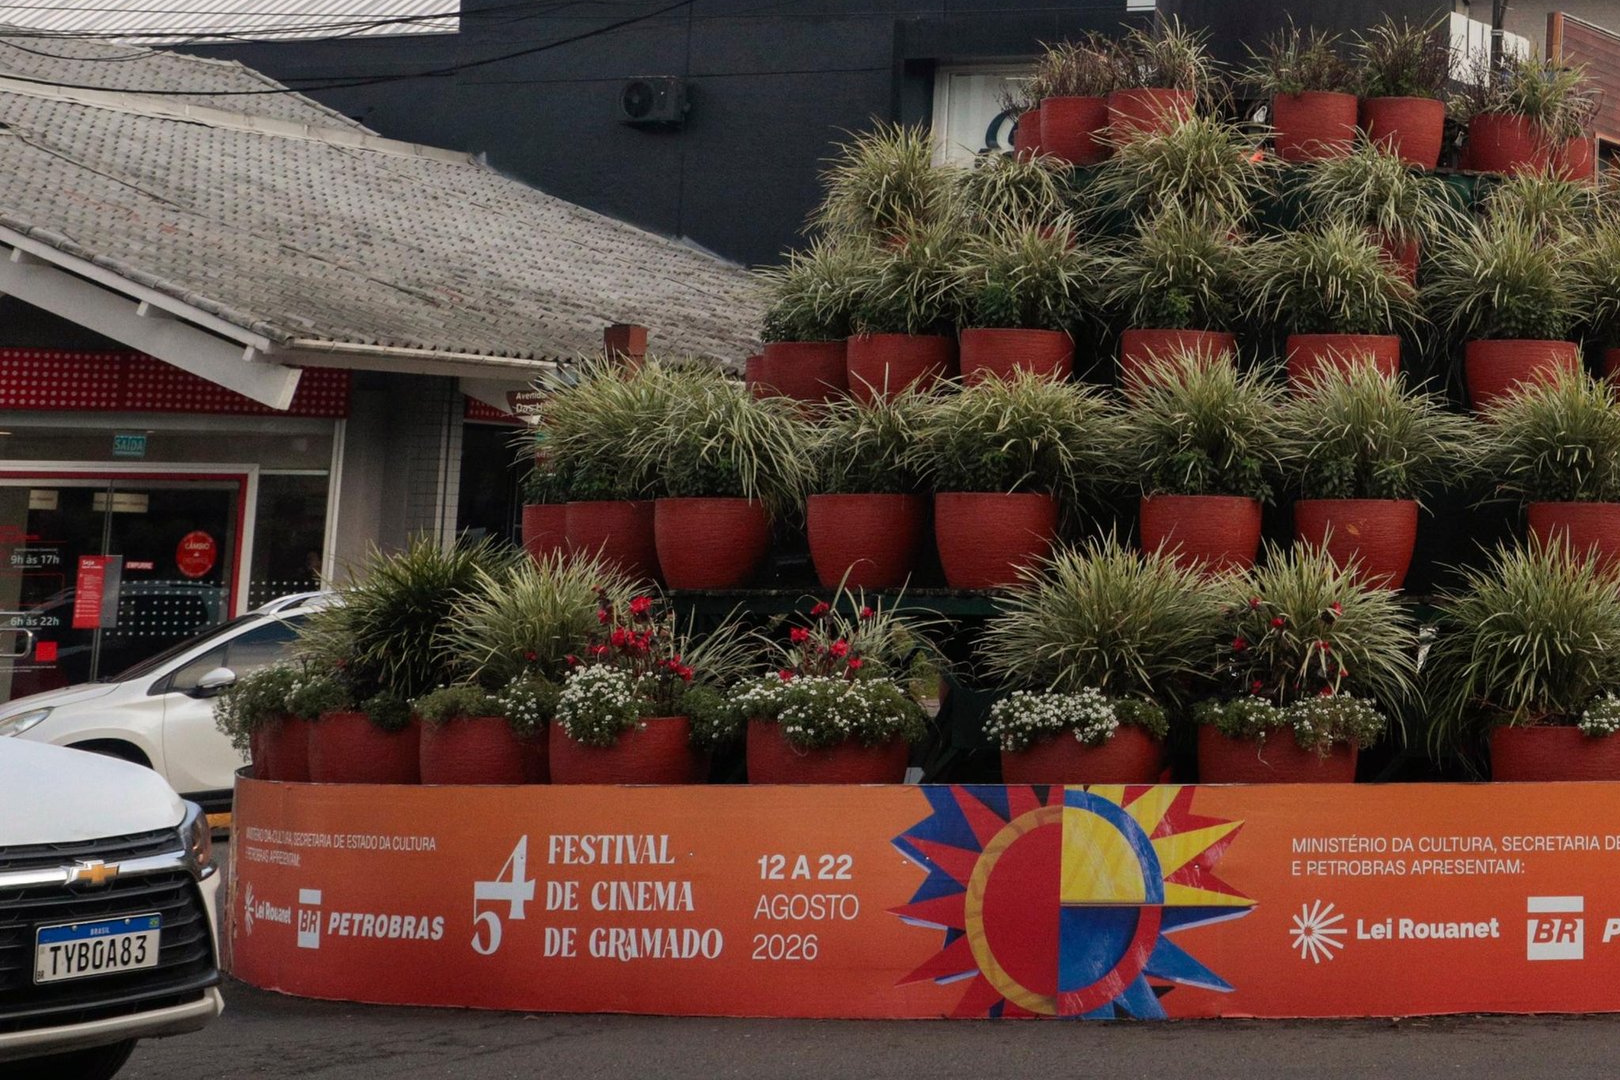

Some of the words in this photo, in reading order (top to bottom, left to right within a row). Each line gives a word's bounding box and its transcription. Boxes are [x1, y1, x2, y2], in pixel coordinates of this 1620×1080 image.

[11, 555, 23, 565] 9h
[41, 555, 60, 565] 17h
[10, 616, 23, 626] 6h
[40, 616, 60, 626] 22h
[334, 834, 345, 848] DE
[346, 834, 377, 849] ESTADO
[379, 836, 391, 850] DA
[392, 836, 436, 851] CULTURA
[548, 834, 675, 865] FESTIVAL
[1292, 834, 1387, 853] MINISTÉRIO
[1392, 838, 1414, 853] DA
[1418, 837, 1498, 854] CULTURA,
[1502, 835, 1600, 851] SECRETARIA
[758, 854, 786, 880] 12
[791, 854, 811, 880] A
[817, 854, 853, 880] 22
[1292, 860, 1301, 876] E
[1307, 860, 1406, 876] PETROBRAS
[1410, 859, 1525, 875] APRESENTAM:
[545, 880, 579, 911] DE
[590, 880, 695, 911] CINEMA
[753, 894, 860, 920] AGOSTO
[255, 900, 265, 919] Lei
[266, 902, 291, 925] Rouanet
[300, 910, 318, 934] BR
[89, 927, 110, 936] BRASIL
[328, 912, 445, 941] PETROBRAS
[1357, 918, 1393, 940] Lei
[1398, 917, 1500, 939] Rouanet
[1532, 918, 1579, 944] BR
[50, 934, 147, 976] TYB0A83
[543, 927, 577, 958] DE
[589, 927, 723, 962] GRAMADO
[751, 934, 818, 960] 2026
